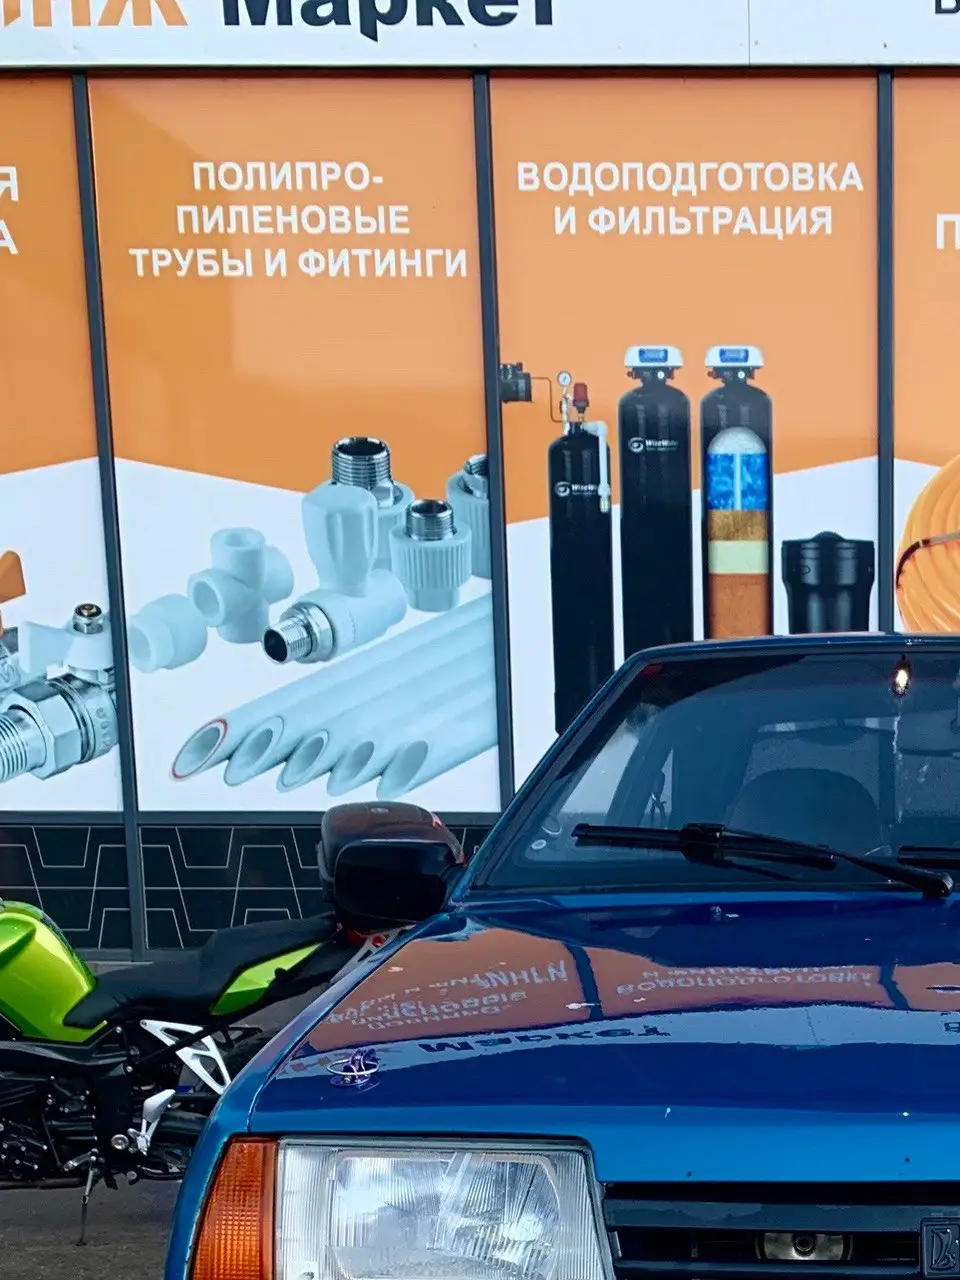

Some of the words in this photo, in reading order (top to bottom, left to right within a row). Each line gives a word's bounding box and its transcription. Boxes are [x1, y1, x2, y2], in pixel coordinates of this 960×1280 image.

[193, 161, 383, 191] ПОЛИПРО-
[517, 161, 864, 197] ВОДОПОДГОТОВКА
[177, 204, 410, 234] ПИЛЕНОВЫЕ
[554, 206, 576, 235] И
[588, 205, 832, 240] ФИЛЬТРАЦИЯ
[129, 248, 253, 278] ТРУБЫ
[264, 248, 287, 277] И
[298, 248, 467, 277] ФИТИНГИ
